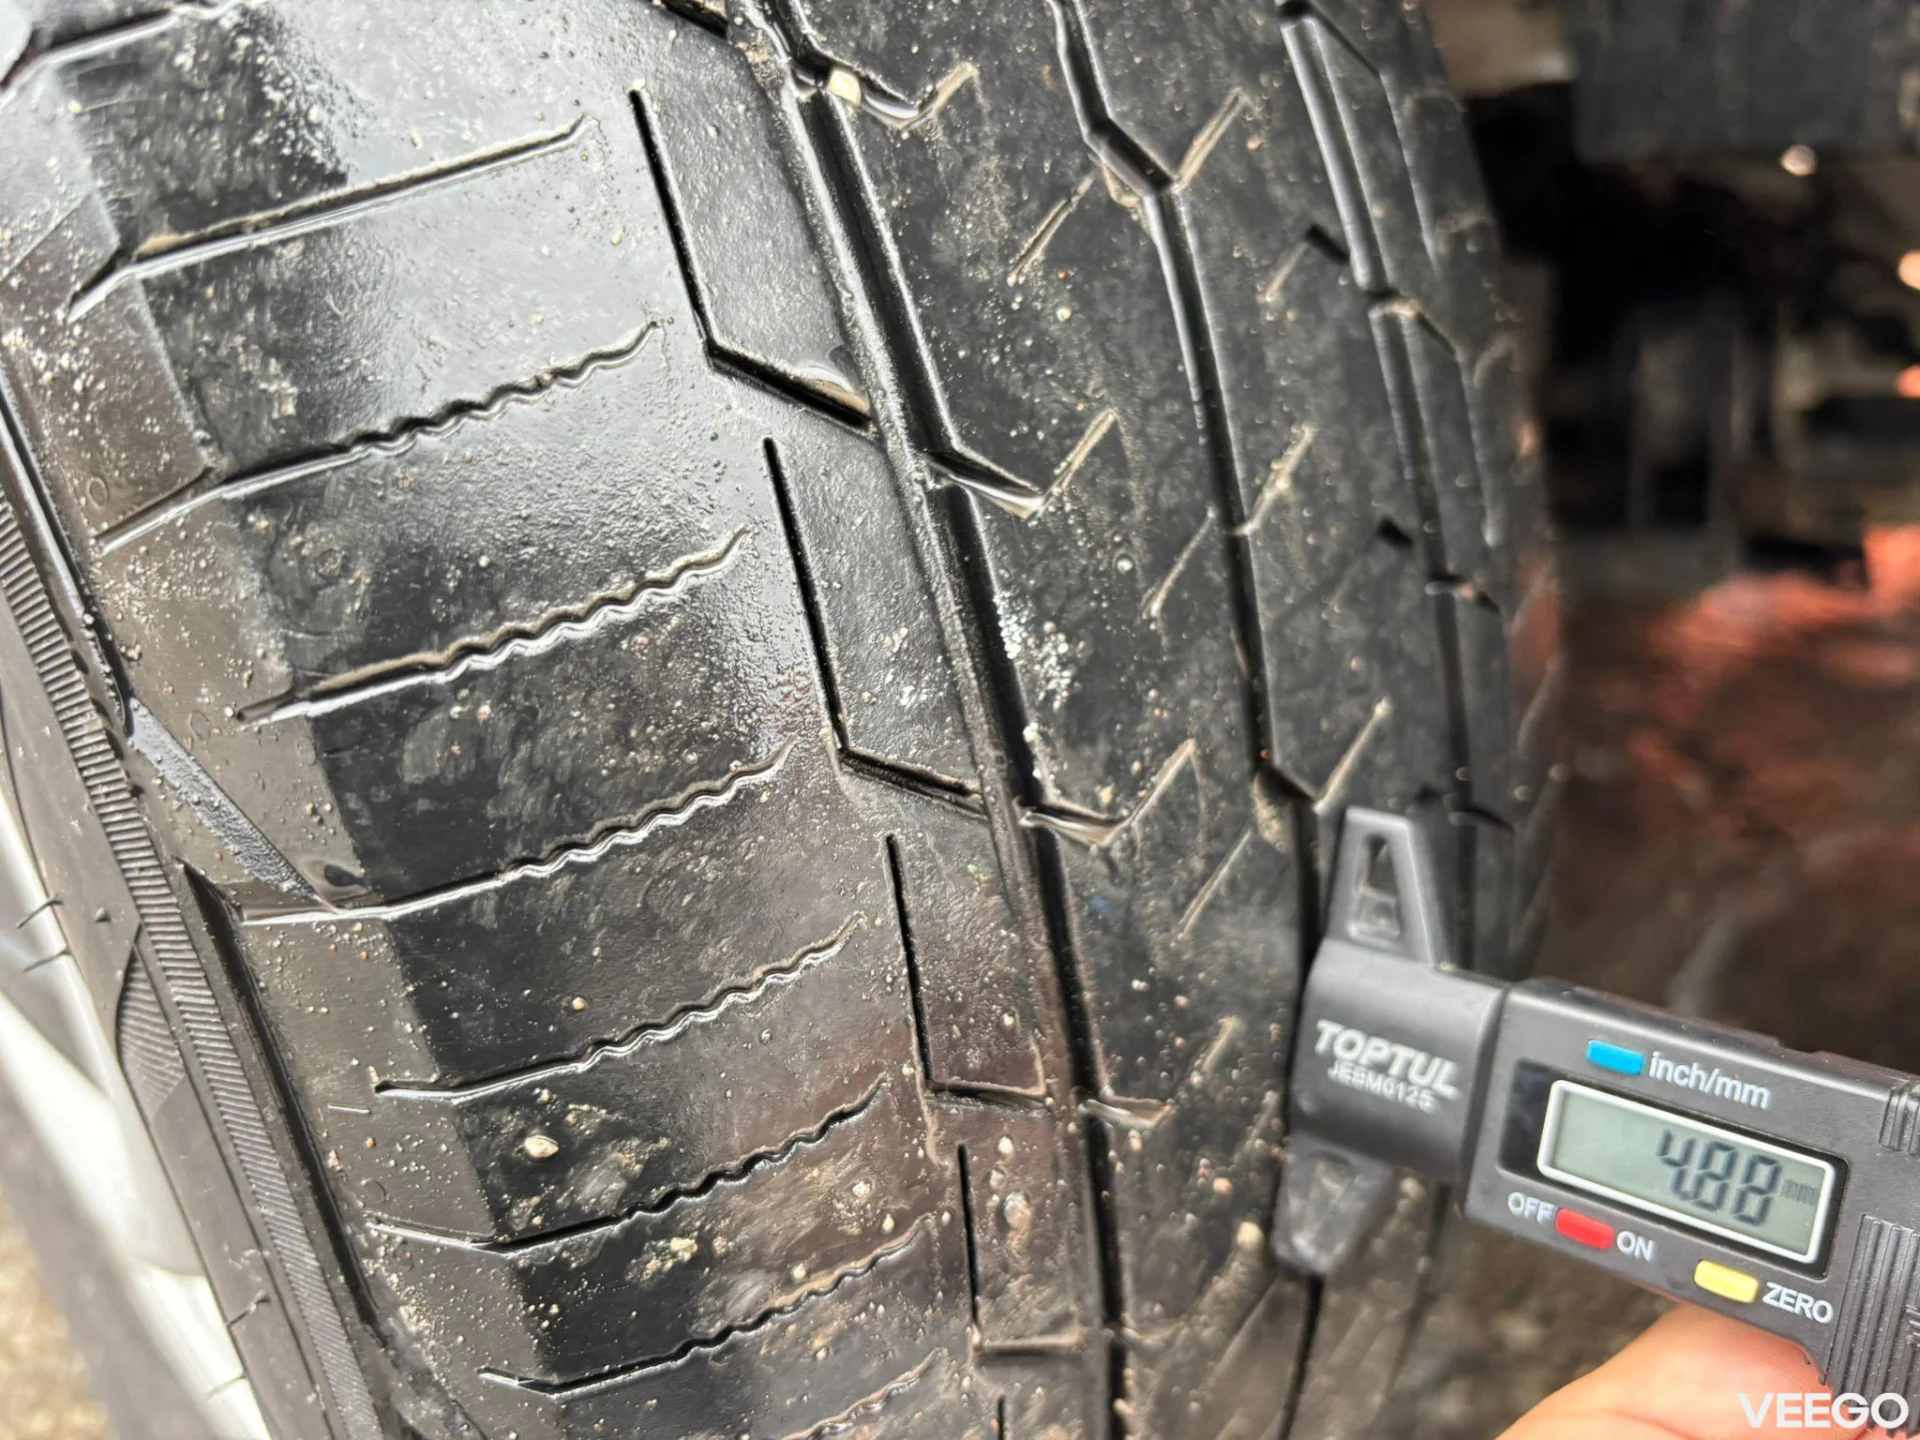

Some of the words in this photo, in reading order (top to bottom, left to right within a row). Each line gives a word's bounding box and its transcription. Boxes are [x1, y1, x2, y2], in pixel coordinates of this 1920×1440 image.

[1315, 1019, 1460, 1100] TOPTUL
[1649, 1051, 1771, 1110] inch/mm
[1507, 1192, 1555, 1224] OFF
[1616, 1230, 1655, 1262] ON
[1762, 1281, 1833, 1324] ZERO
